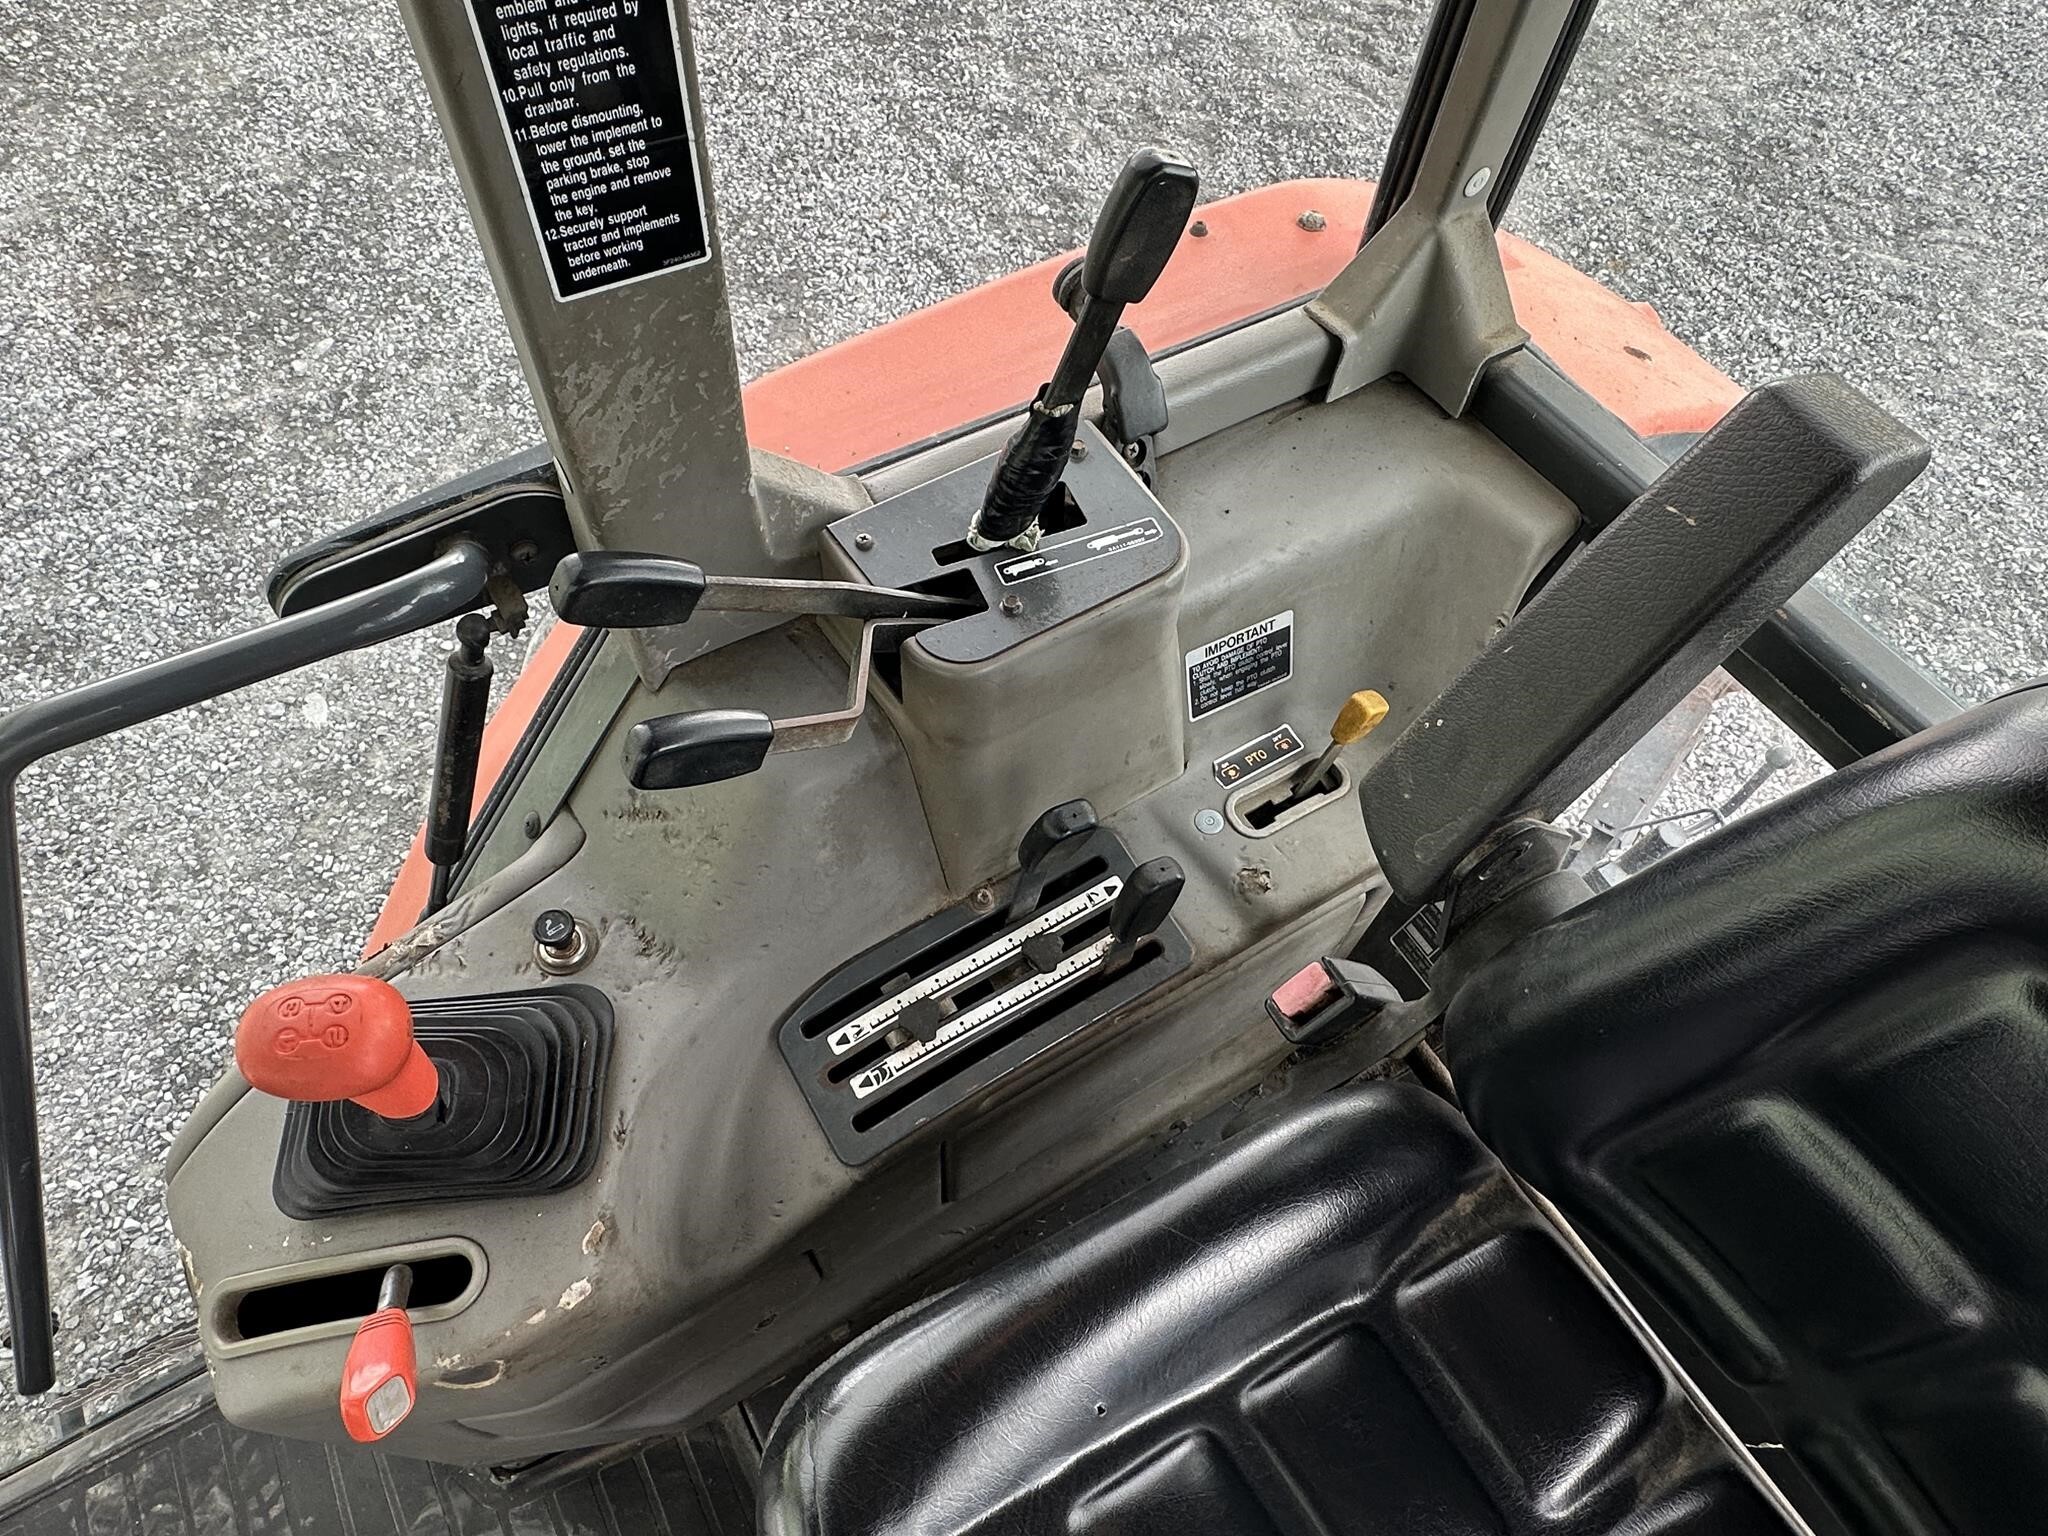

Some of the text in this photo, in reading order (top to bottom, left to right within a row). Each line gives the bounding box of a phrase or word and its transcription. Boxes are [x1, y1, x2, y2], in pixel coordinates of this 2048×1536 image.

[495, 0, 579, 19] emblem an
[500, 0, 639, 43] lights, if required by
[506, 24, 616, 61] local traffic and
[513, 46, 630, 81] safety regulations.
[550, 76, 575, 93] only
[581, 69, 611, 86] from
[616, 63, 636, 78] the
[524, 97, 580, 119] drawbar.
[571, 103, 644, 130] dismounting,
[535, 116, 663, 157] lower the implement to
[540, 139, 646, 175] the ground, set the
[546, 154, 650, 192] parking brake, stop
[550, 166, 672, 207] the engine and remove
[554, 203, 598, 223] the key.
[608, 204, 648, 225] support
[563, 213, 681, 253] tractor and implements
[567, 239, 644, 268] before working
[572, 258, 631, 282] underneath.
[1204, 619, 1276, 658] IMPORTANT
[1192, 637, 1268, 674] TO AVOID DAMAGE OF PTO
[1224, 664, 1236, 673] PTO
[1271, 649, 1283, 659] PTO
[1192, 668, 1215, 680] CLUTCH
[1216, 660, 1229, 670] AND
[1246, 673, 1258, 683] PTO
[1244, 749, 1268, 767] PTO
